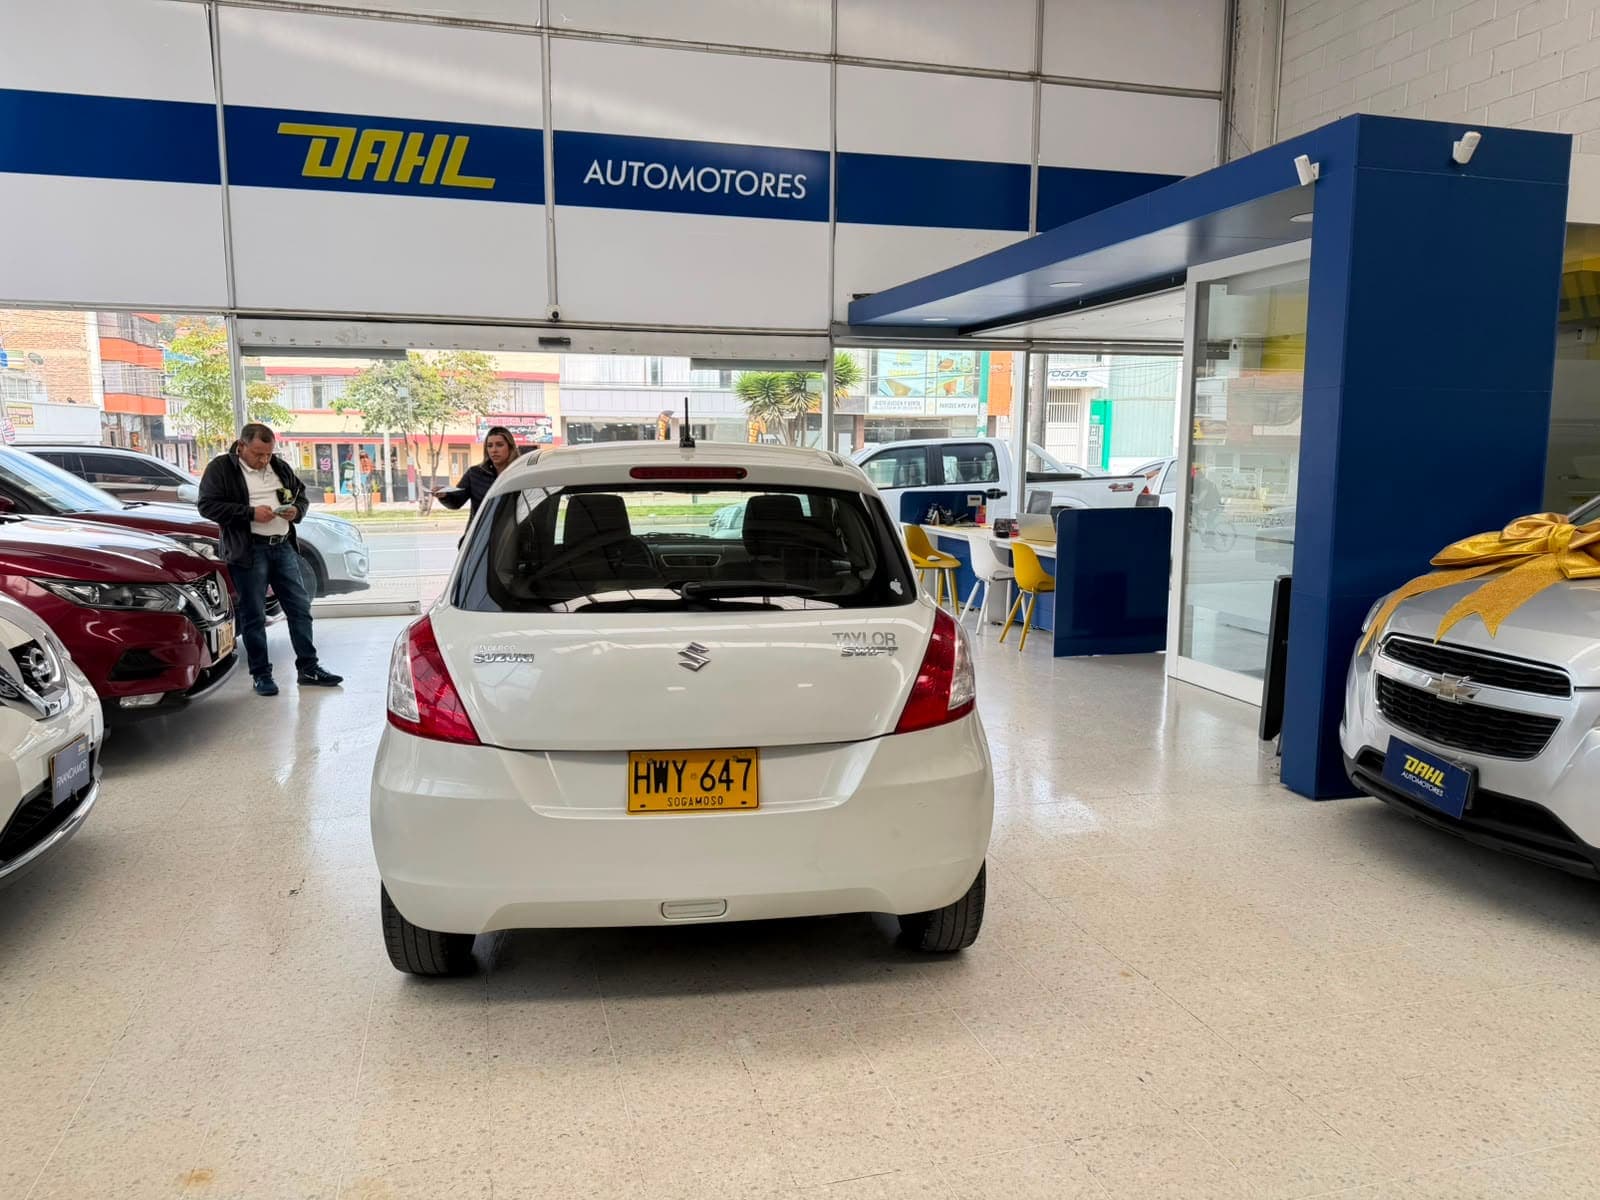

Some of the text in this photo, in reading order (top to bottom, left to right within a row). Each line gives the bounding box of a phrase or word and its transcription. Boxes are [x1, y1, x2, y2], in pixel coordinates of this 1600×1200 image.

[277, 122, 807, 201] DAHL AUTOMOTORES
[831, 631, 897, 646] TAYLOR
[473, 652, 535, 663] SUZUKI
[841, 646, 899, 658] SWIFT
[633, 758, 752, 794] HWY 647
[1404, 754, 1445, 788] DAHL
[1401, 772, 1444, 797] AUTOMOTORES
[667, 795, 725, 808] SOGAMOSO
